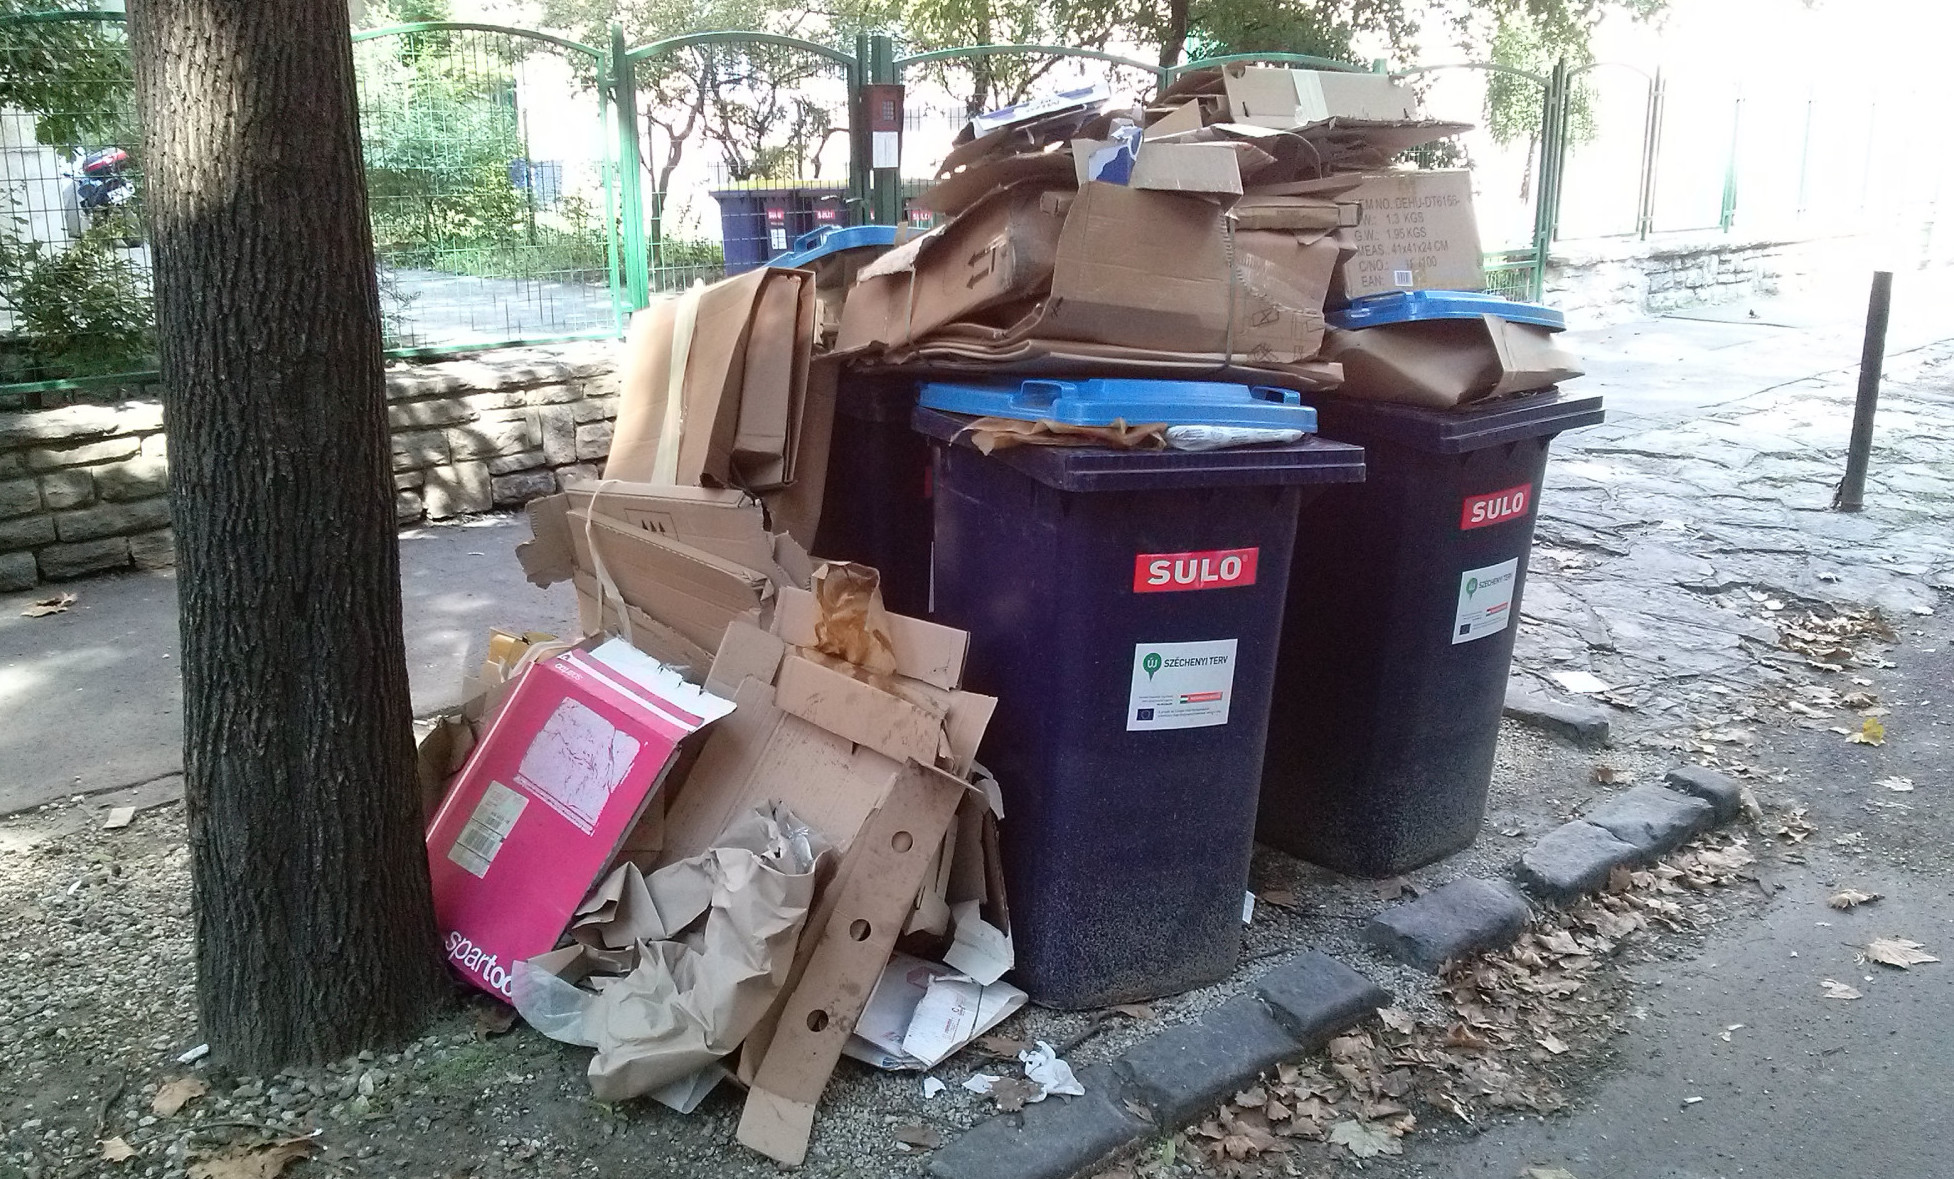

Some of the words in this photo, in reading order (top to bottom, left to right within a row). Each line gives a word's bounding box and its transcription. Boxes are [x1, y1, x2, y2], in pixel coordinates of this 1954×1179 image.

[1404, 211, 1424, 223] KGS
[1407, 227, 1427, 238] KGS
[1434, 240, 1449, 251] CM
[1470, 491, 1524, 523] SULO
[1147, 555, 1242, 585] SULO
[1163, 657, 1208, 668] SZÉCHENYI
[1209, 655, 1229, 666] TERV
